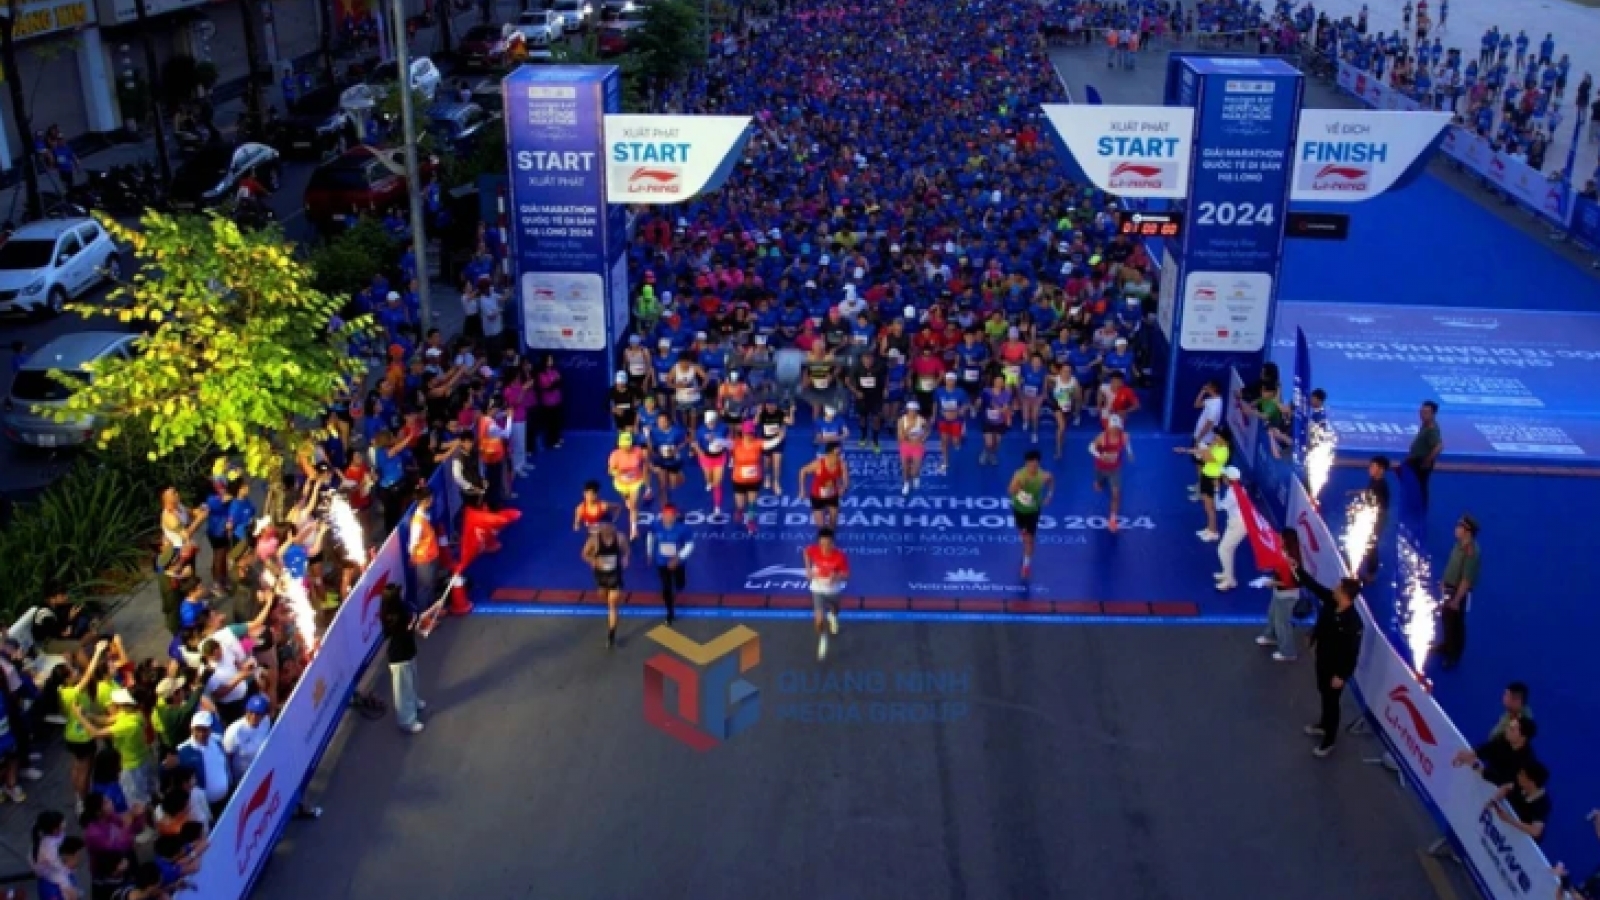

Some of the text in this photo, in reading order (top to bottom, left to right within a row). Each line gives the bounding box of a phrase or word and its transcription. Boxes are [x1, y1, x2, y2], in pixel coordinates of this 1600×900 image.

[613, 141, 692, 163] START
[1097, 135, 1181, 157] START
[1226, 148, 1284, 158] MARATHON
[1303, 141, 1388, 163] FINISH
[517, 150, 595, 171] START
[541, 205, 597, 214] MARATHON
[1196, 201, 1275, 226] 2024
[903, 514, 954, 531] HẠ
[1064, 515, 1157, 531] 2024
[931, 546, 980, 556] 2024
